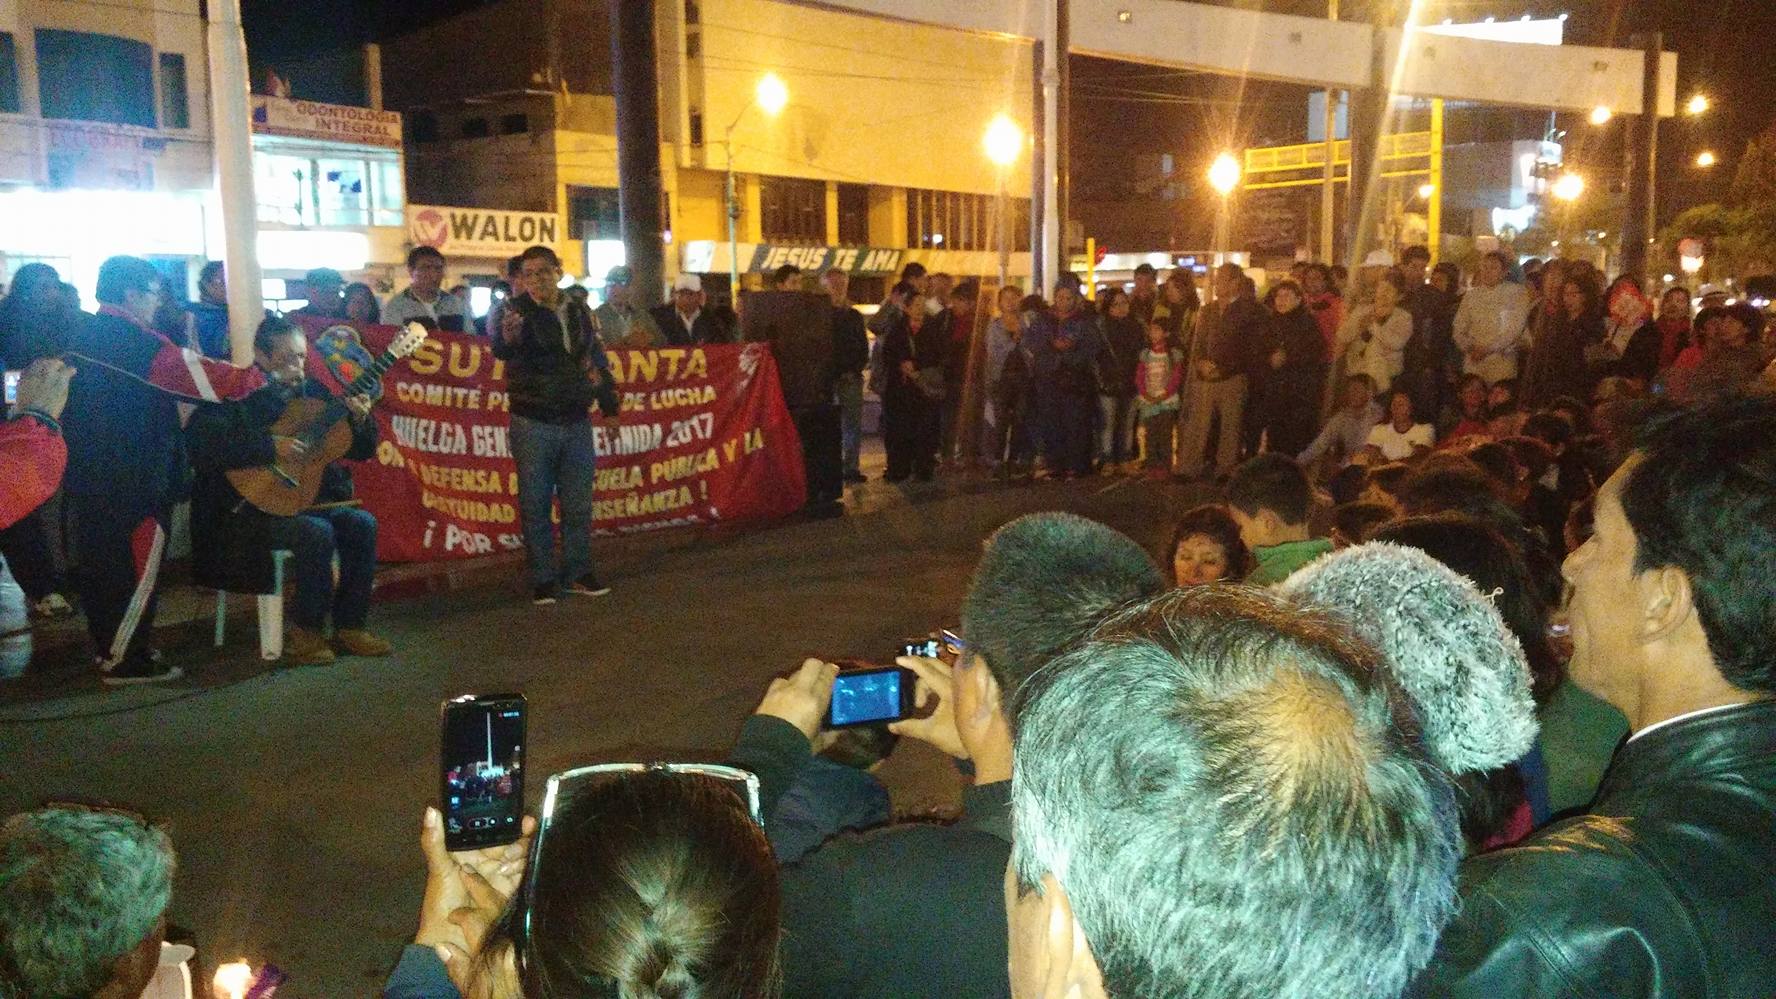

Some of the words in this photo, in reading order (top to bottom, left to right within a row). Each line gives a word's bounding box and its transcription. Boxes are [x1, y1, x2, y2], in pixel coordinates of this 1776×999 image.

[315, 118, 391, 137] INTEGRAL
[449, 211, 556, 243] WALON
[831, 248, 860, 271] TE
[859, 250, 901, 272] AMA
[621, 391, 646, 411] DE
[650, 385, 718, 411] LUCHA
[666, 412, 715, 448] 2017
[722, 438, 740, 463] Y
[743, 427, 765, 455] LA
[444, 522, 495, 555] POR
